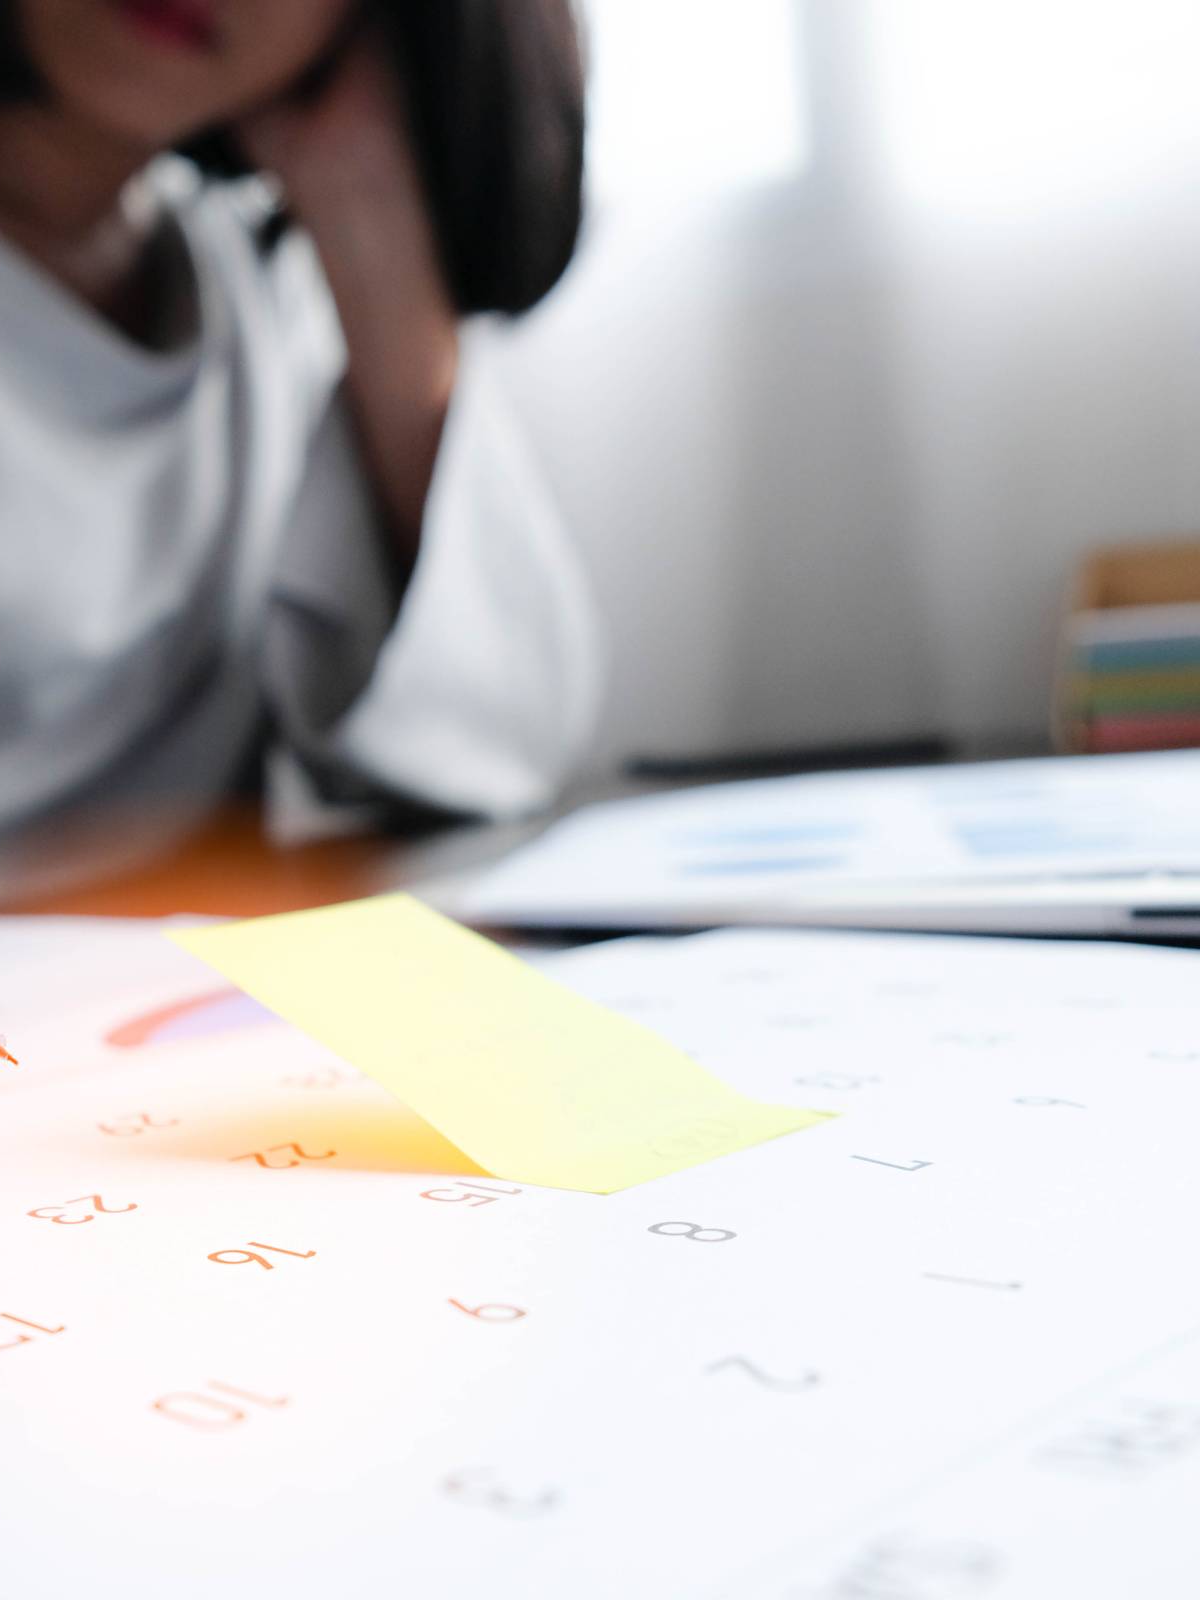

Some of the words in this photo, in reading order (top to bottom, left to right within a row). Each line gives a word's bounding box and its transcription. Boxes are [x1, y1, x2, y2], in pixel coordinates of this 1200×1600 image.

[97, 1110, 182, 1136] 29
[228, 1141, 338, 1169] 22
[850, 1155, 933, 1172] 7
[418, 1181, 522, 1208] 15
[27, 1194, 138, 1224] 23
[647, 1221, 737, 1242] 8
[207, 1241, 316, 1270] 16
[923, 1273, 1023, 1292] 1
[447, 1297, 528, 1323] 9
[704, 1354, 822, 1392] 2
[150, 1380, 290, 1430] 10
